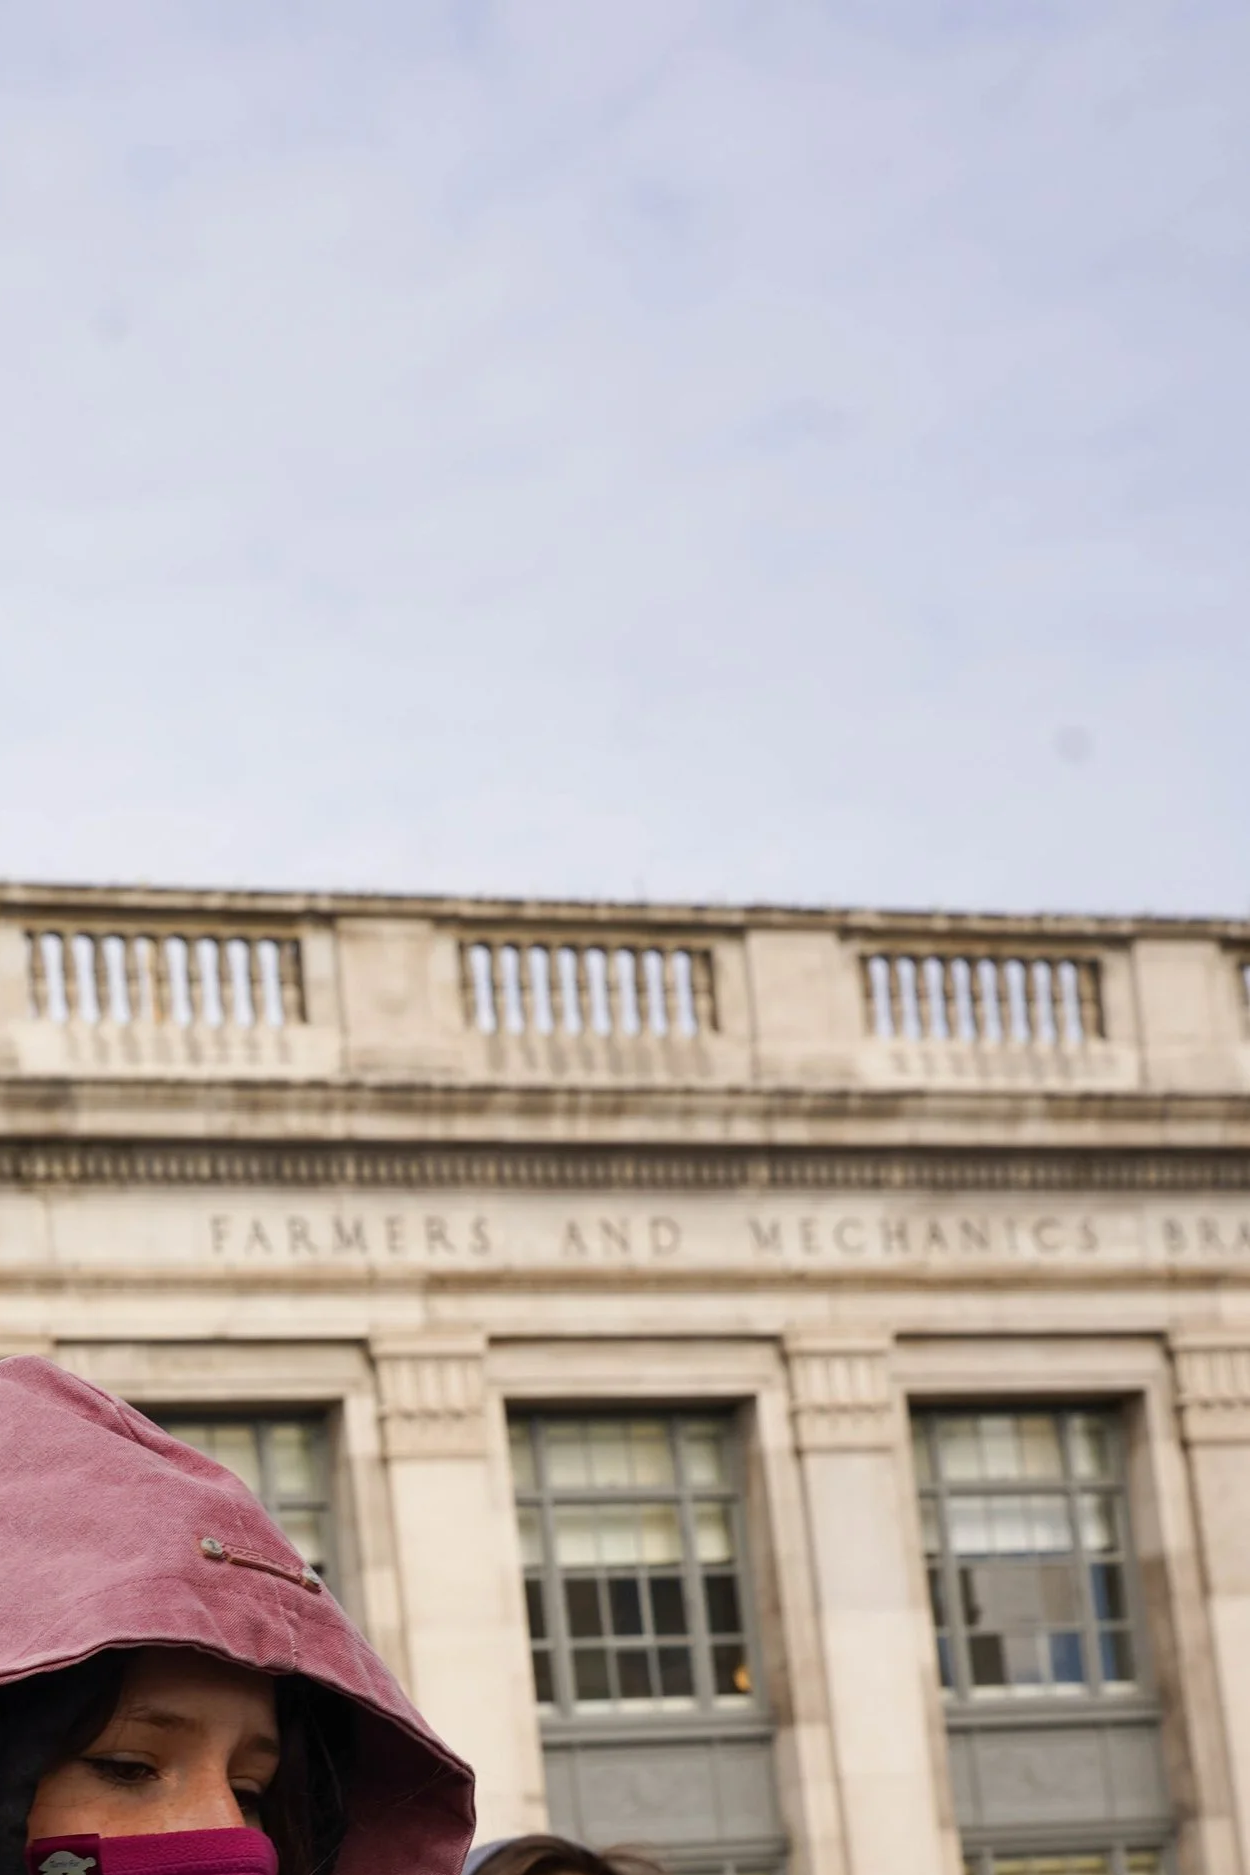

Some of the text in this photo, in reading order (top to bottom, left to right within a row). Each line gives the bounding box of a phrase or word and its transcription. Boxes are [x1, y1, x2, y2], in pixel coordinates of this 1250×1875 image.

[209, 1214, 493, 1256] FARMERS
[560, 1215, 682, 1257] AND
[748, 1216, 1100, 1256] MECHANICS
